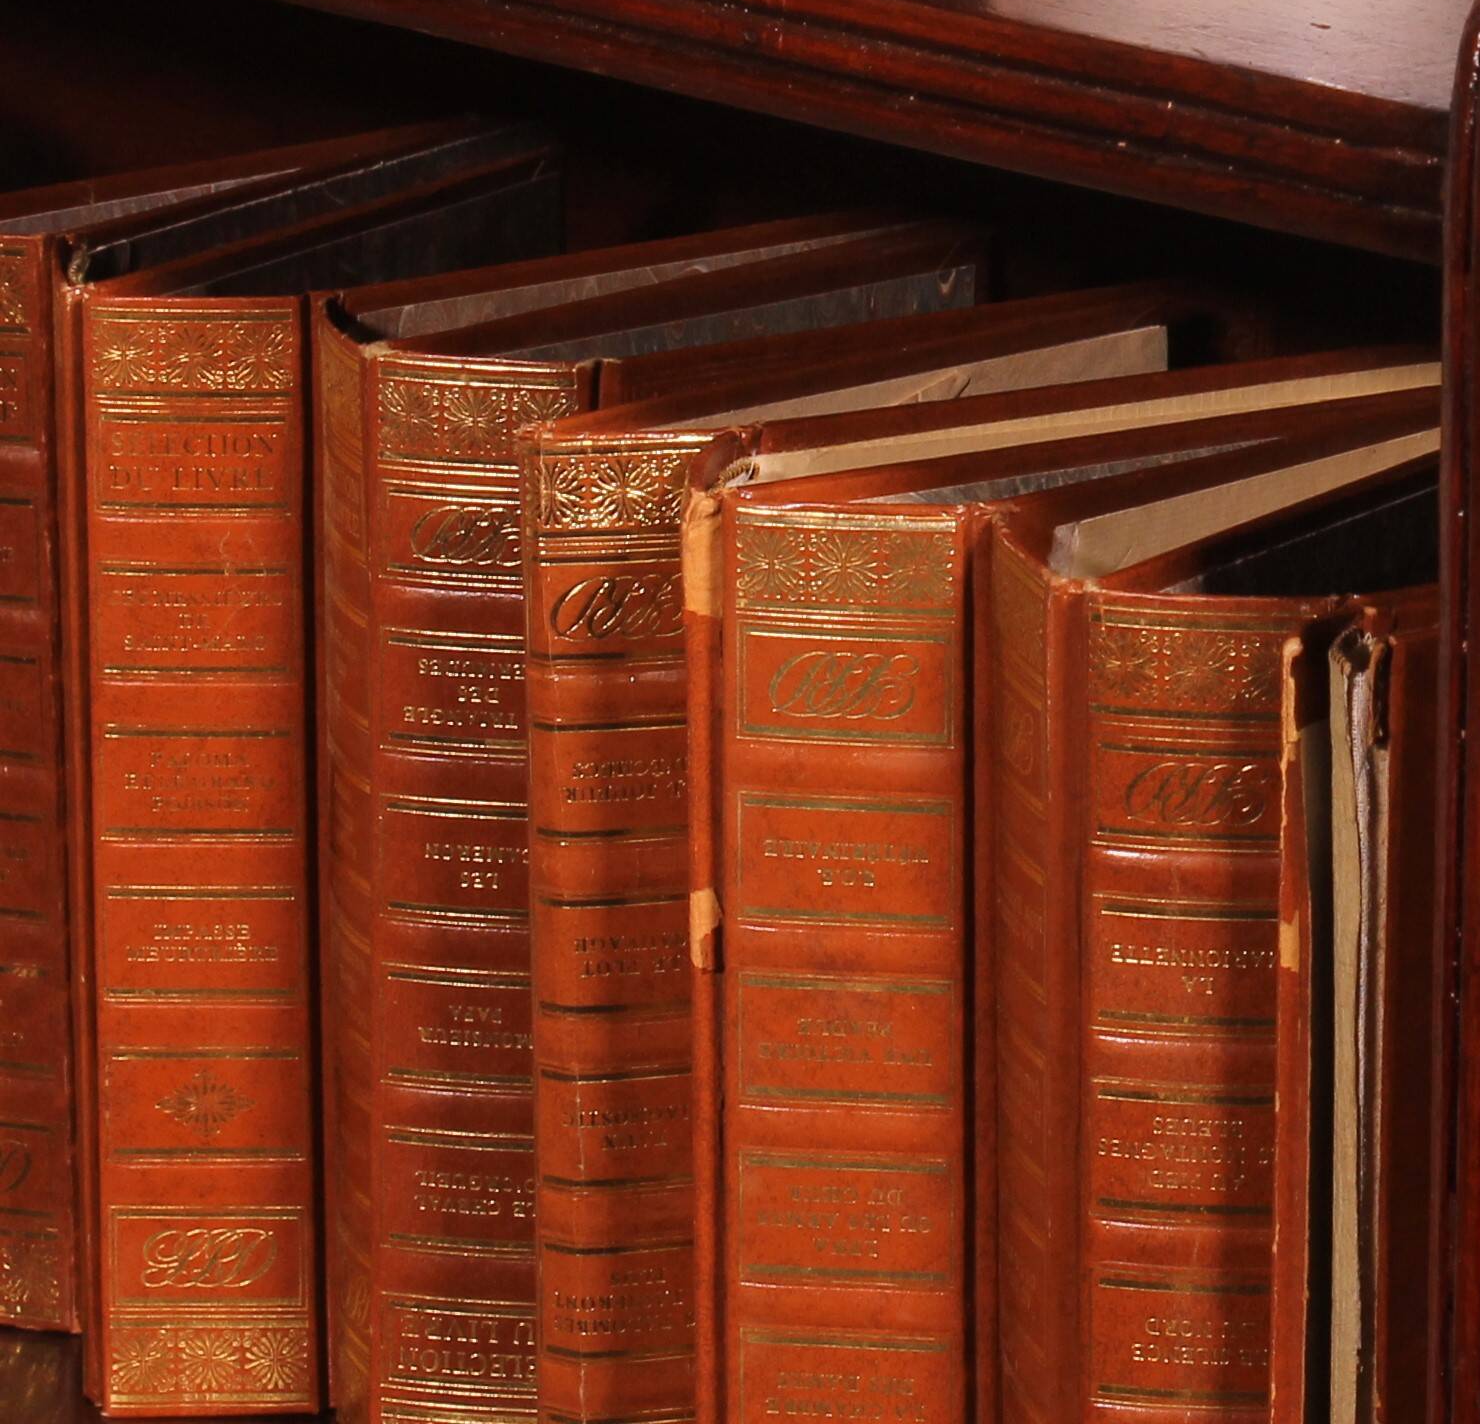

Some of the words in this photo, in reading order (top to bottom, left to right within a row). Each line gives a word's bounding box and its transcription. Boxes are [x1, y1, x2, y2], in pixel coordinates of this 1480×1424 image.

[172, 466, 275, 492] LIVRE
[456, 685, 499, 704] DES
[402, 705, 518, 730] TRIANGLE
[459, 871, 498, 890] LES
[1181, 976, 1214, 995] LA
[448, 1004, 502, 1025] PAPA
[417, 1026, 533, 1050] MONSIEUR
[401, 1315, 499, 1343] LIVRE
[398, 1346, 535, 1382] ÉLECTION
